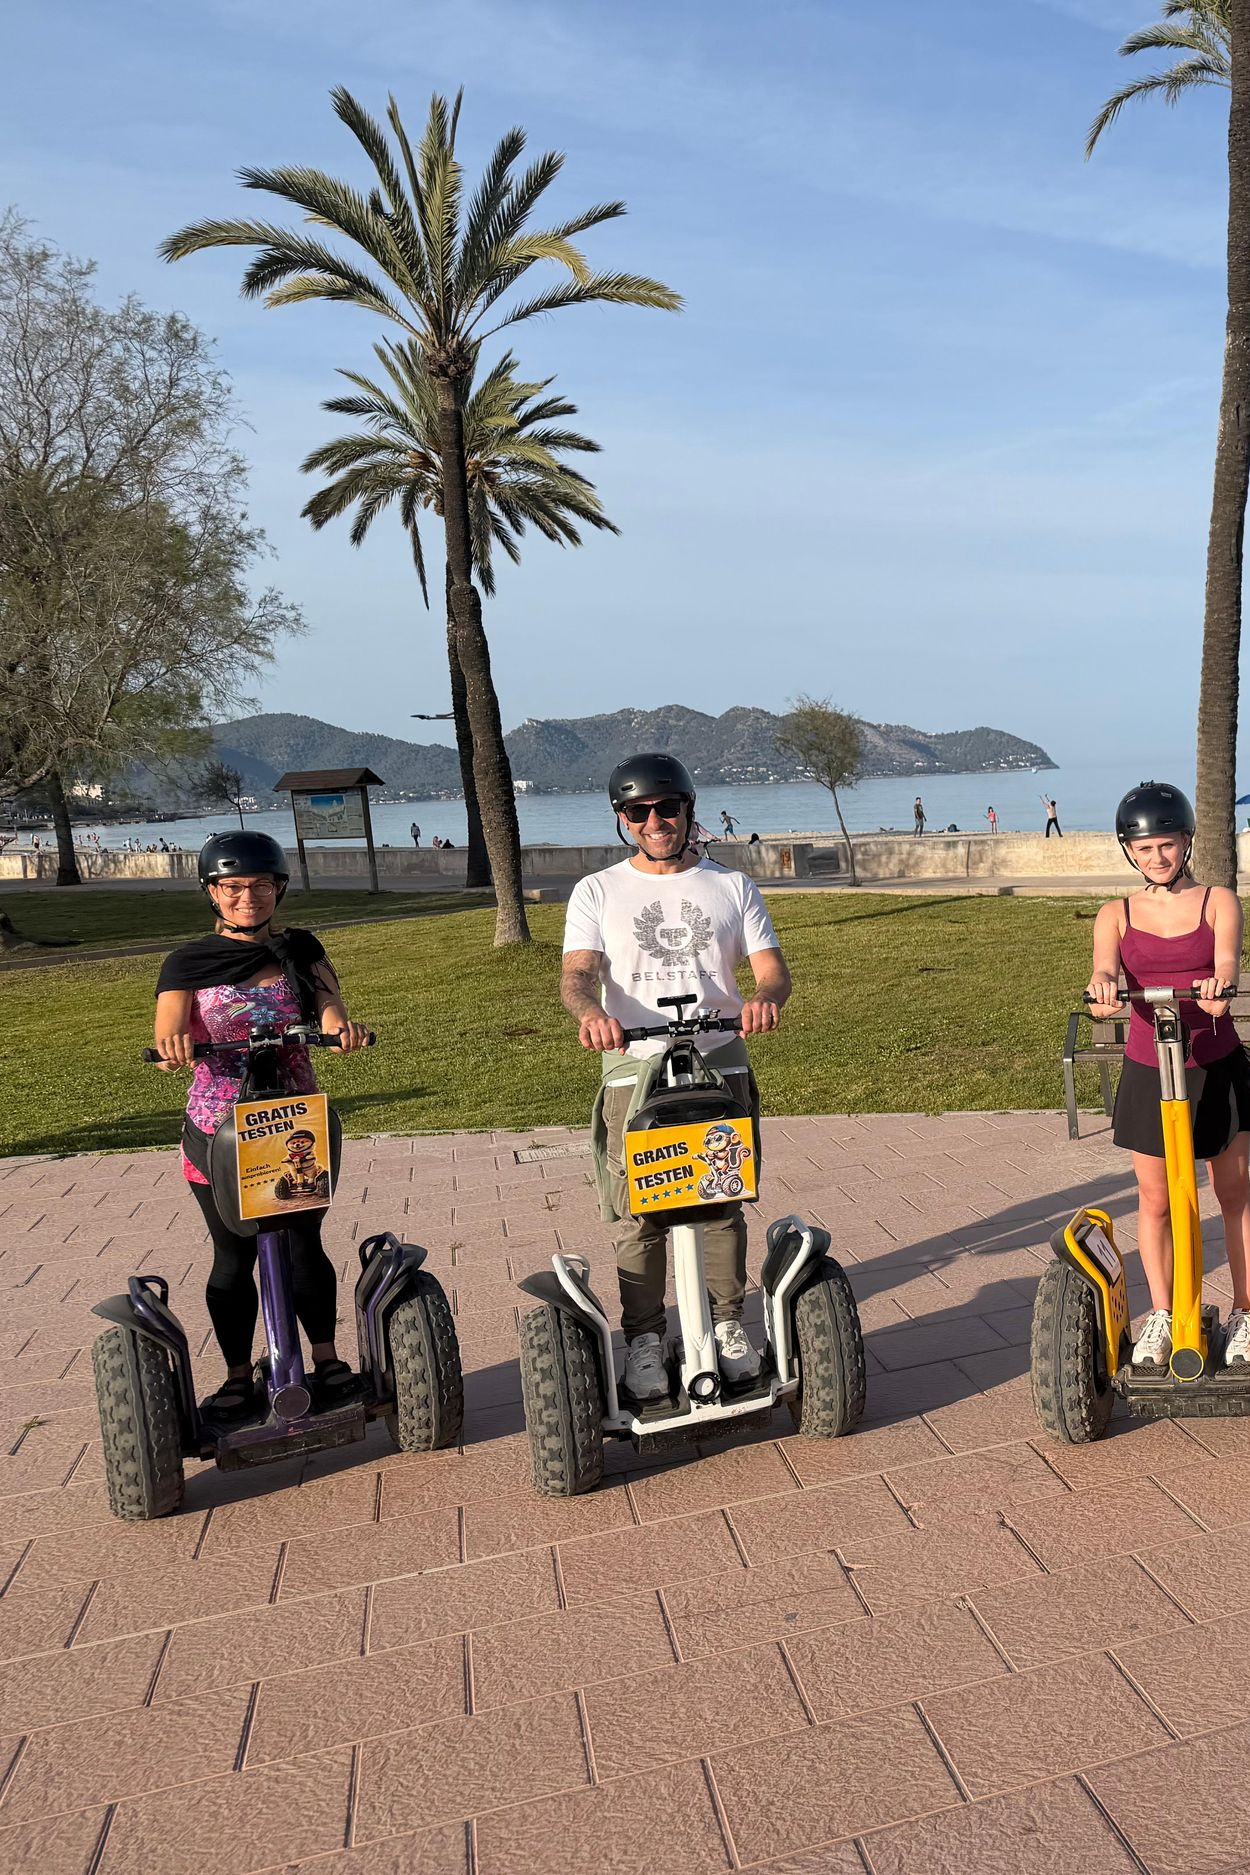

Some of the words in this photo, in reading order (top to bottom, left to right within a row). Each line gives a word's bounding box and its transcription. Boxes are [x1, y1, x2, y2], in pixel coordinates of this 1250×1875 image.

[632, 970, 718, 982] BELSTAFF
[245, 1102, 308, 1127] GRATIS
[238, 1120, 295, 1142] TESTEN
[633, 1142, 689, 1167] GRATIS
[634, 1164, 694, 1191] TESTEN
[1097, 1239, 1116, 1268] 11
